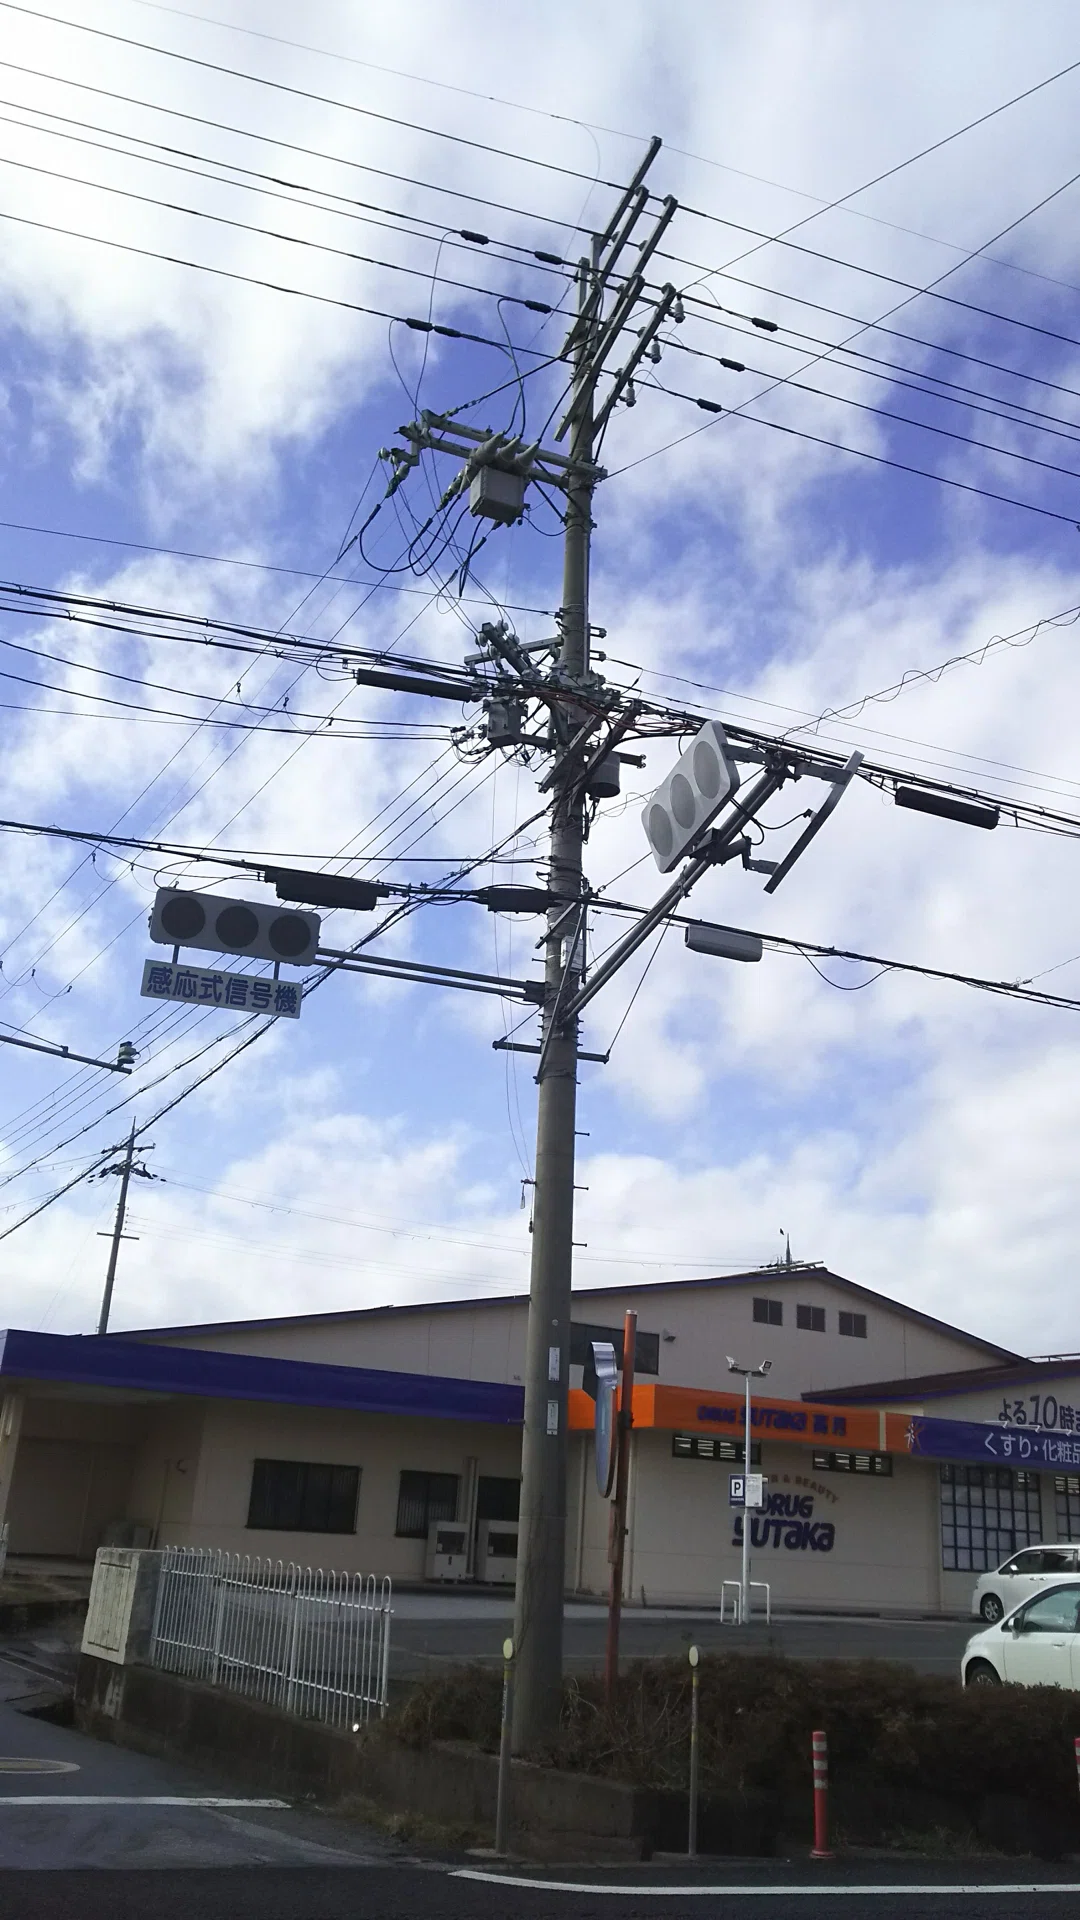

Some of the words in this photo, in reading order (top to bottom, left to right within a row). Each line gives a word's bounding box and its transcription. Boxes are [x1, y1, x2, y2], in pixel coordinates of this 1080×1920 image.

[147, 966, 298, 1014] 感応式信号機
[734, 1481, 741, 1494] P
[795, 1475, 839, 1504] BEAUTY
